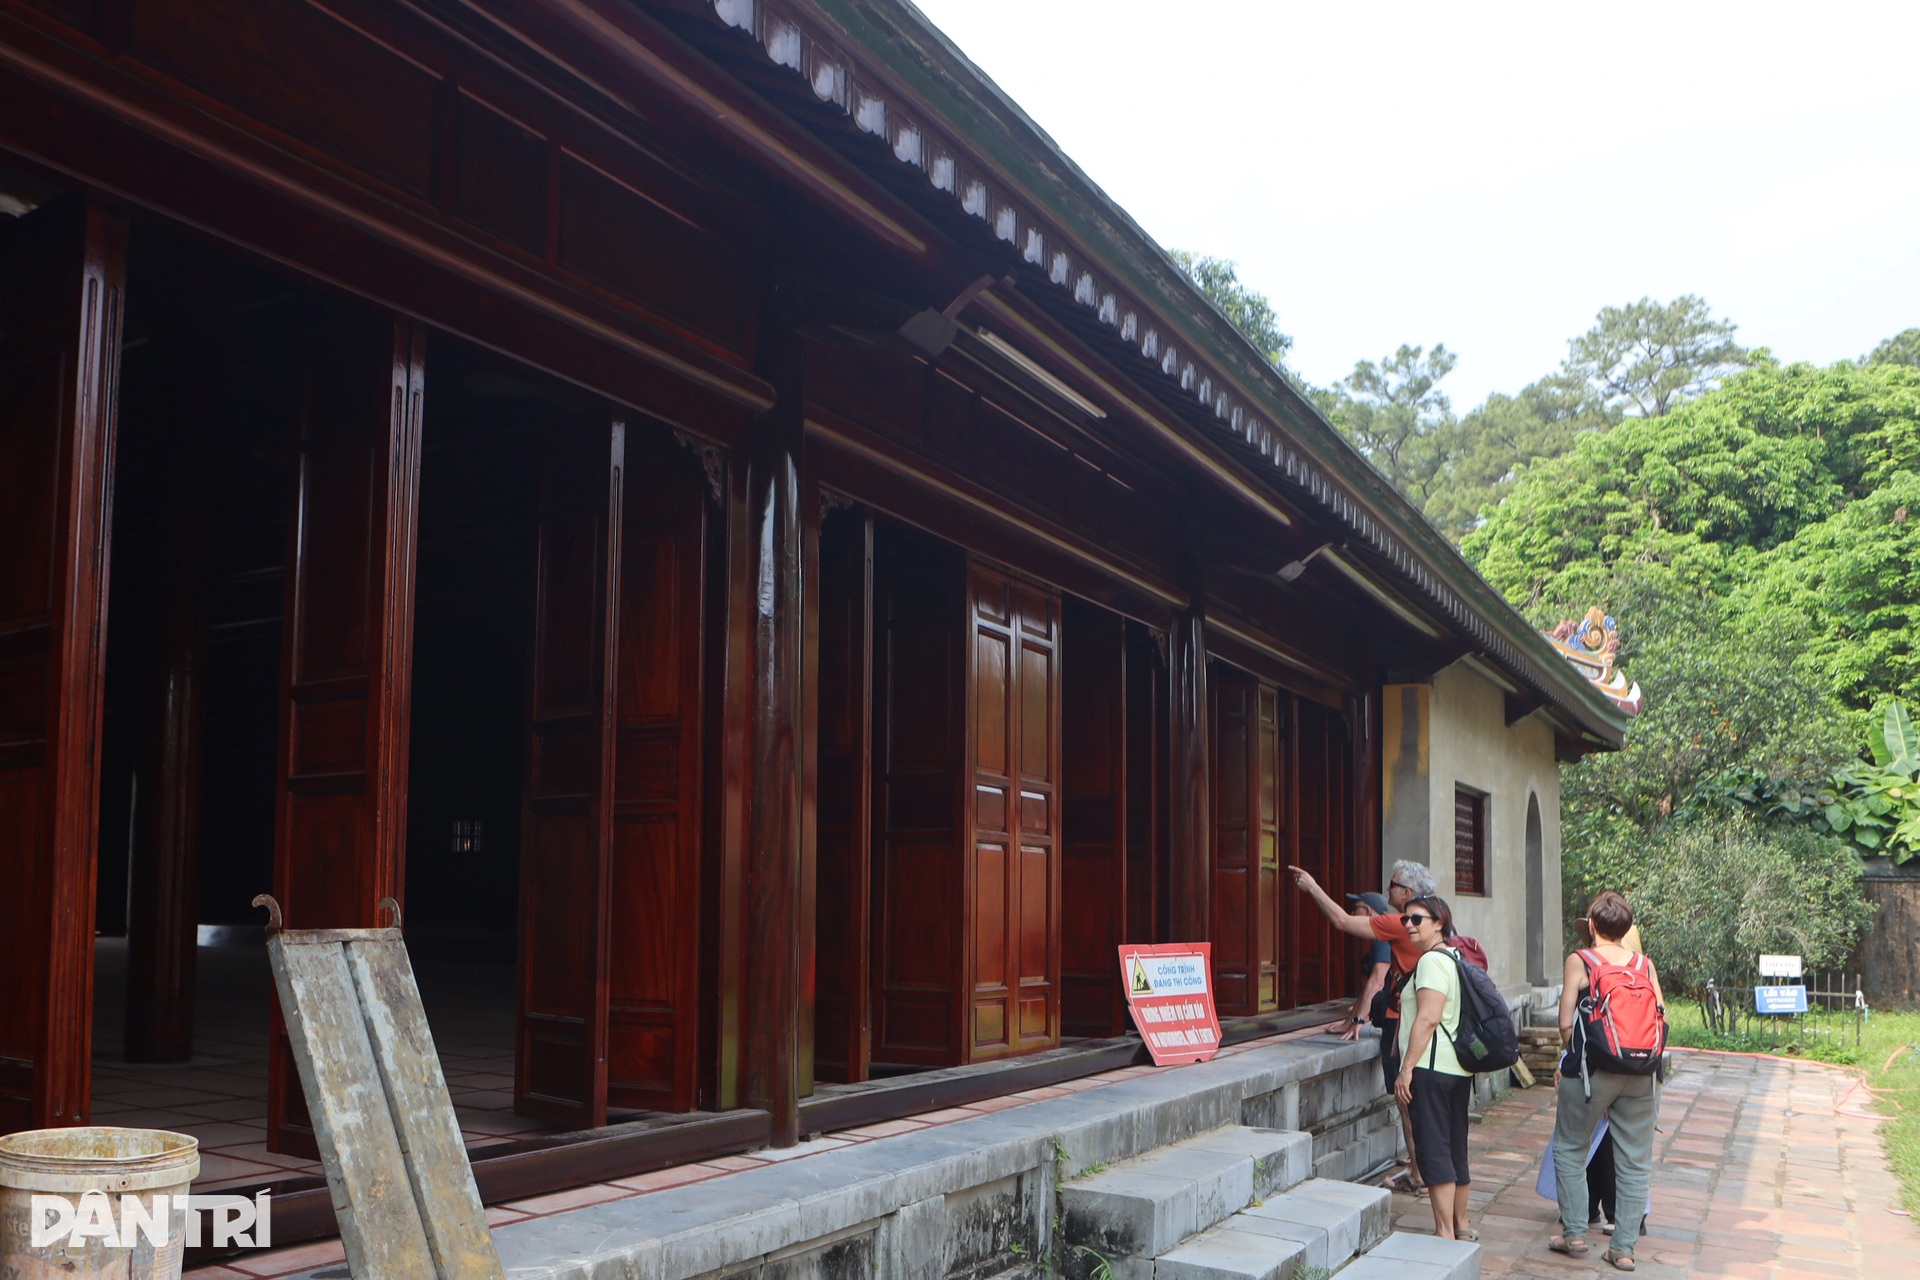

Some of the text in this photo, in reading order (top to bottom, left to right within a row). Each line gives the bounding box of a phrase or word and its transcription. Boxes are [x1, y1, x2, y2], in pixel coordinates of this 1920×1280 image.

[1157, 963, 1196, 975] CÔNG TRÌNH
[1153, 975, 1203, 988] ĐANG THI CÔNG
